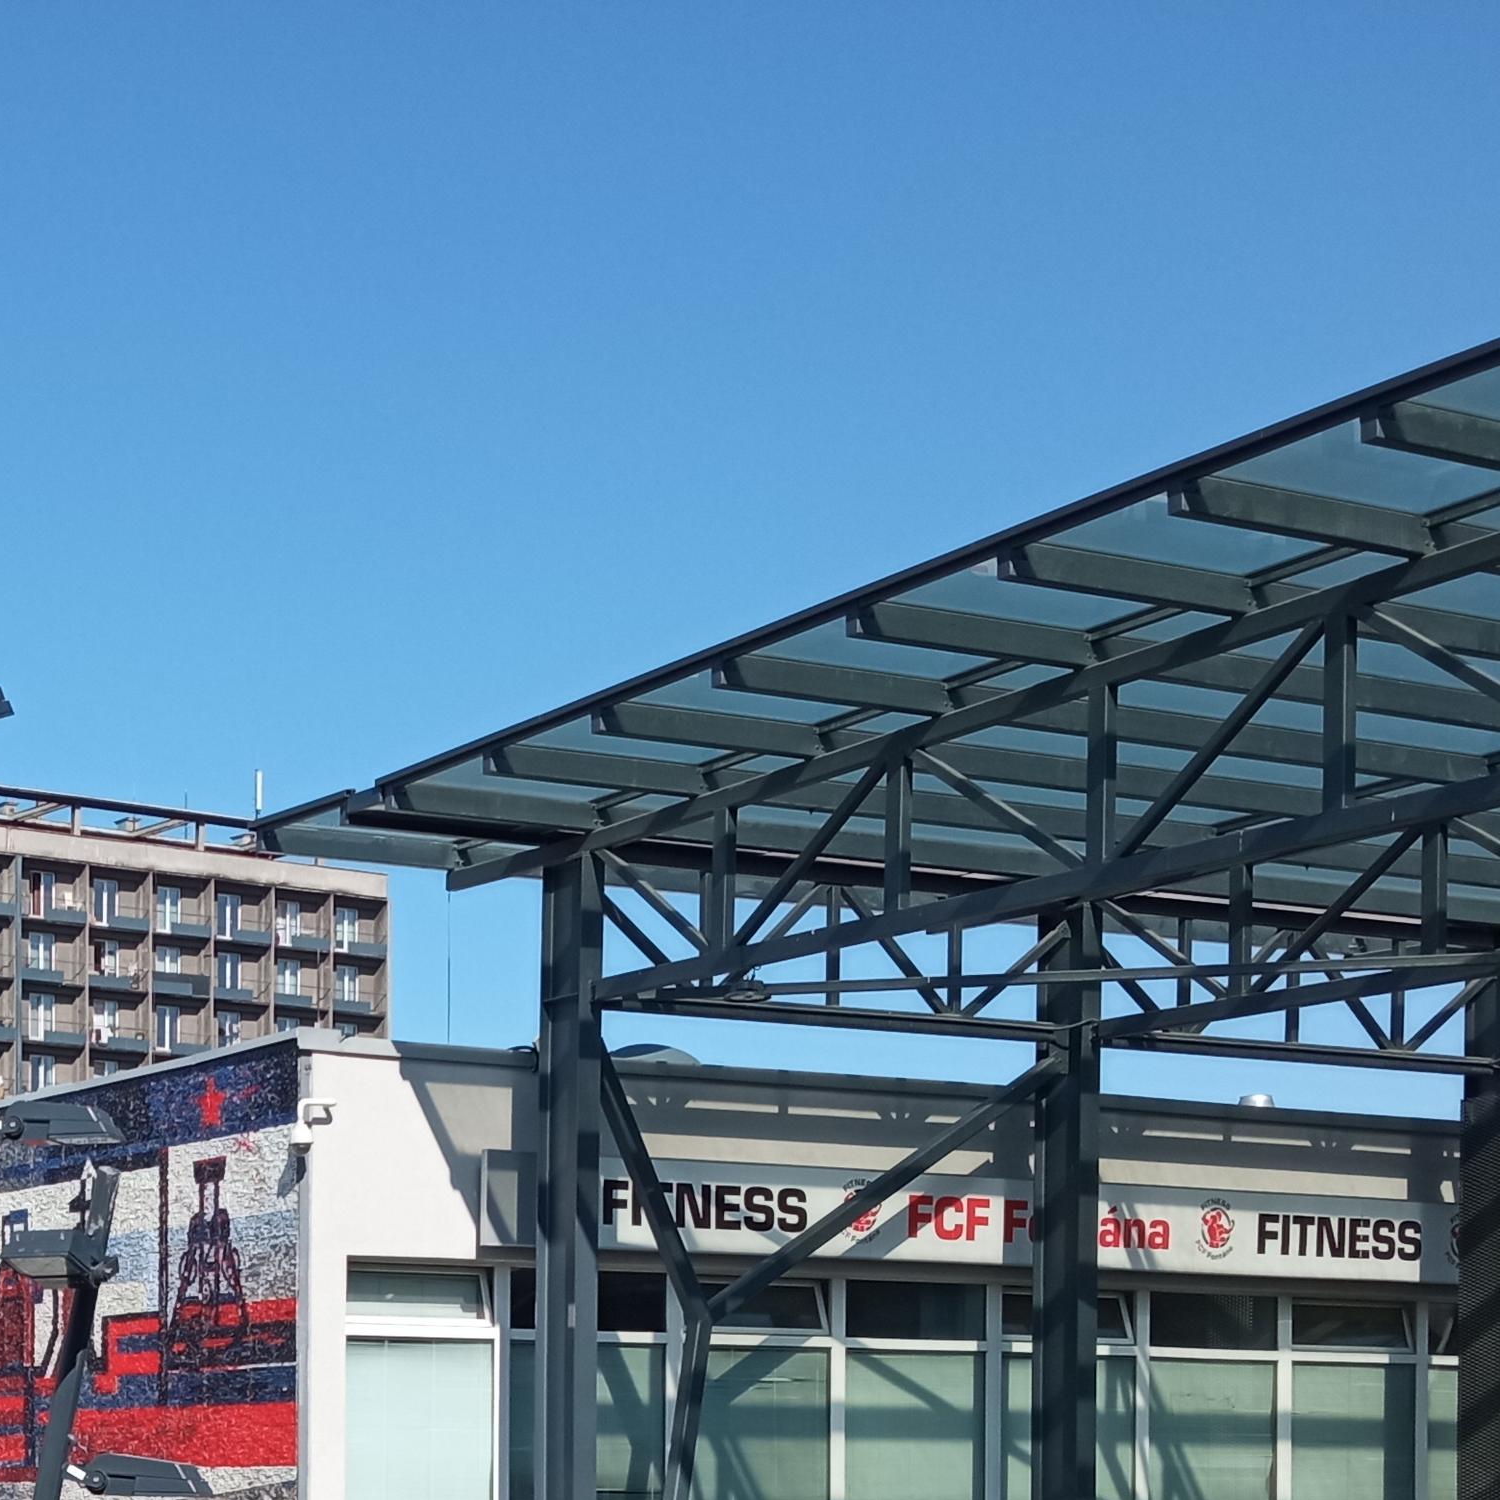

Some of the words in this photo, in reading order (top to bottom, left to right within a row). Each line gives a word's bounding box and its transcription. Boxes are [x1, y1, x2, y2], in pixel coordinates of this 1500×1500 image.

[907, 1194, 991, 1242] FCF
[1003, 1200, 1170, 1250] Fána
[1256, 1212, 1423, 1262] FITNESS
